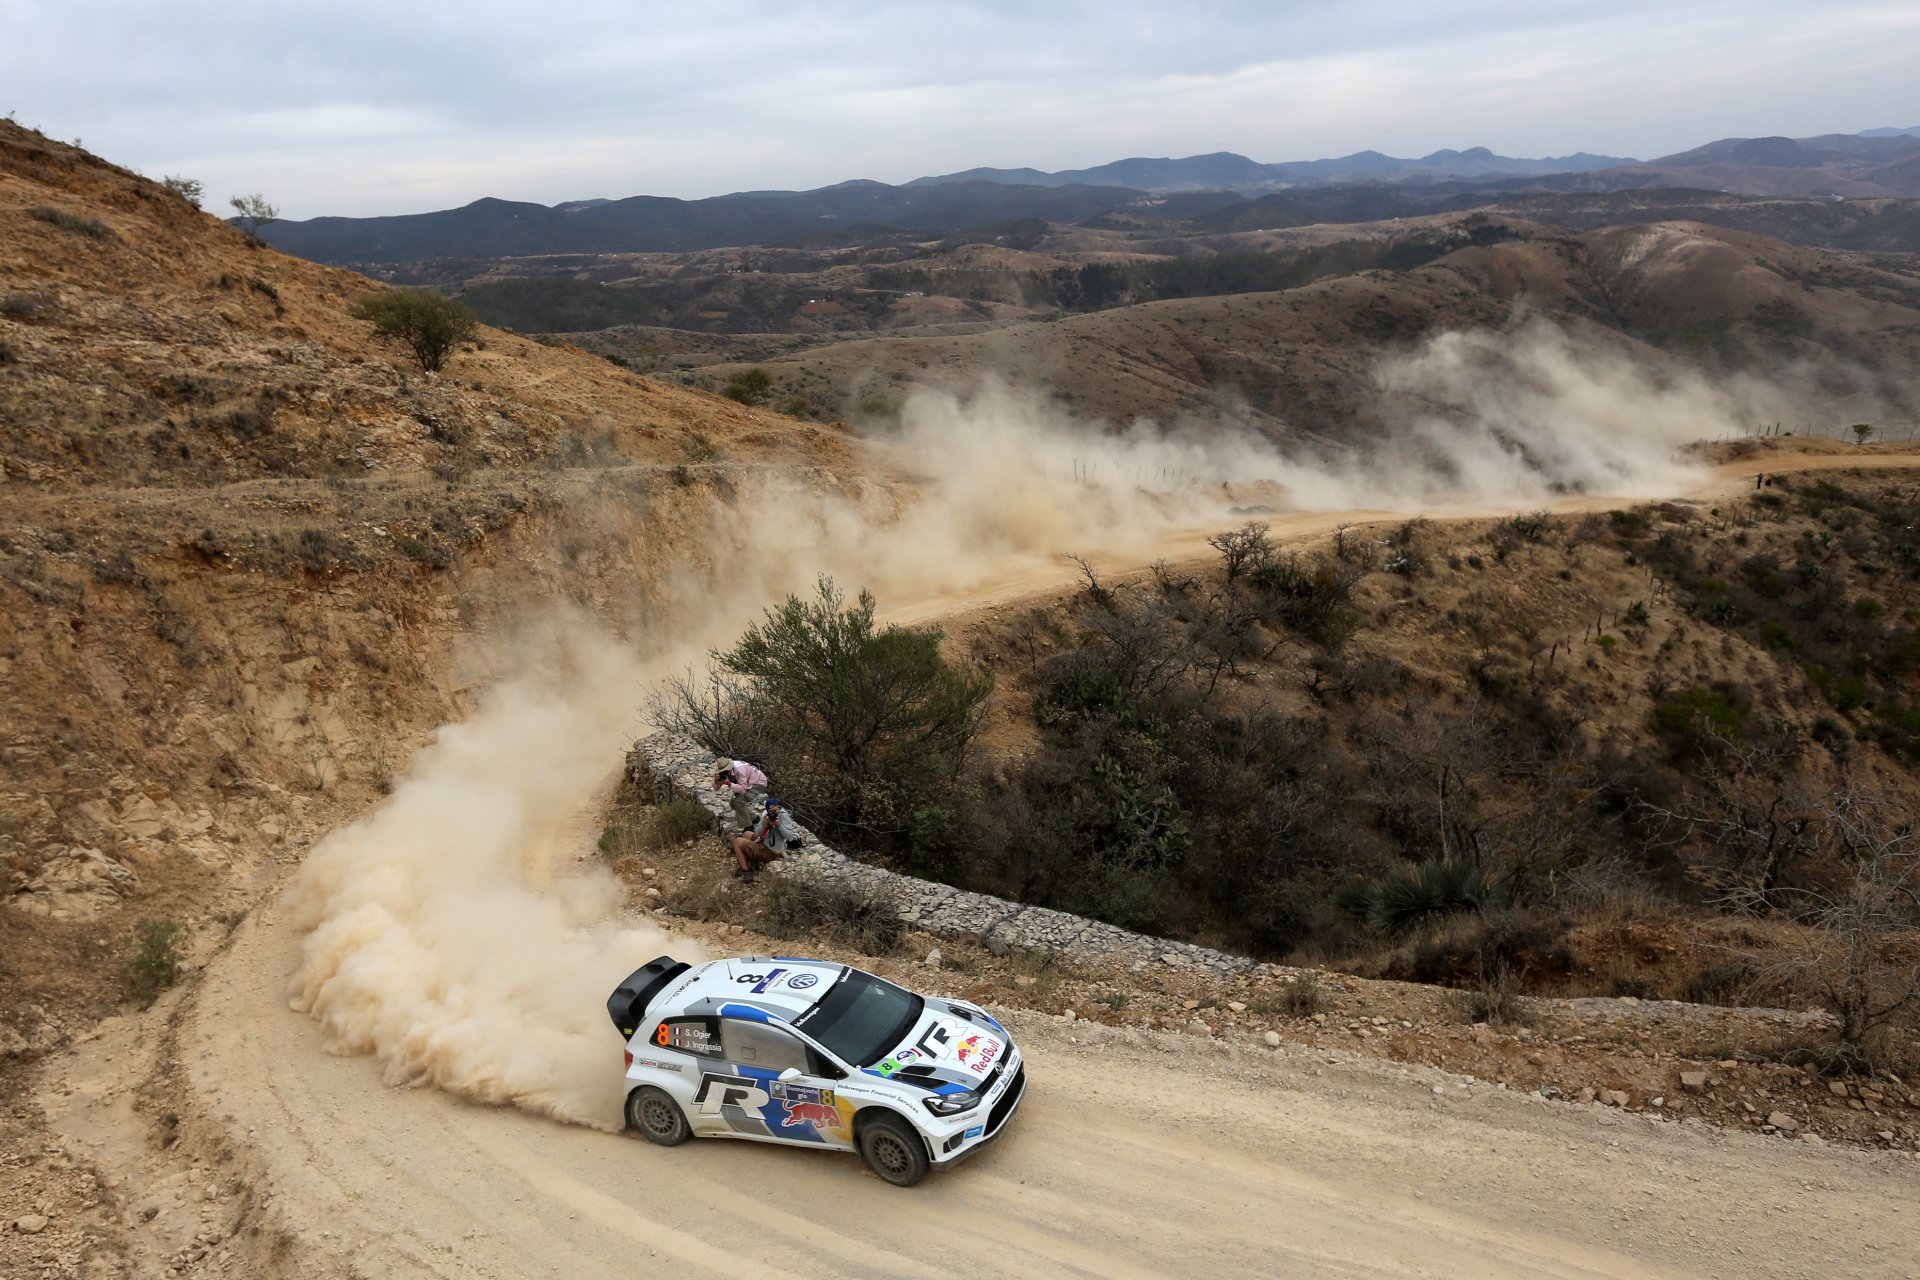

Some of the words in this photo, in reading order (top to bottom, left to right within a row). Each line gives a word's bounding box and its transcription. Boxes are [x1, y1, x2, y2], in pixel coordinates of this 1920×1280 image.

[736, 974, 764, 984] 8
[657, 1023, 670, 1046] 8
[685, 1028, 692, 1037] S.
[693, 1029, 711, 1040] Ogier
[685, 1040, 692, 1048] J.
[692, 1041, 722, 1052] Ingrassia
[970, 1053, 992, 1074] Red
[983, 1038, 1001, 1057] Bull
[882, 1062, 893, 1071] 8
[822, 1089, 833, 1106] 8
[837, 1083, 870, 1093] Volkswagen
[870, 1089, 897, 1099] Financial
[897, 1096, 919, 1114] Services
